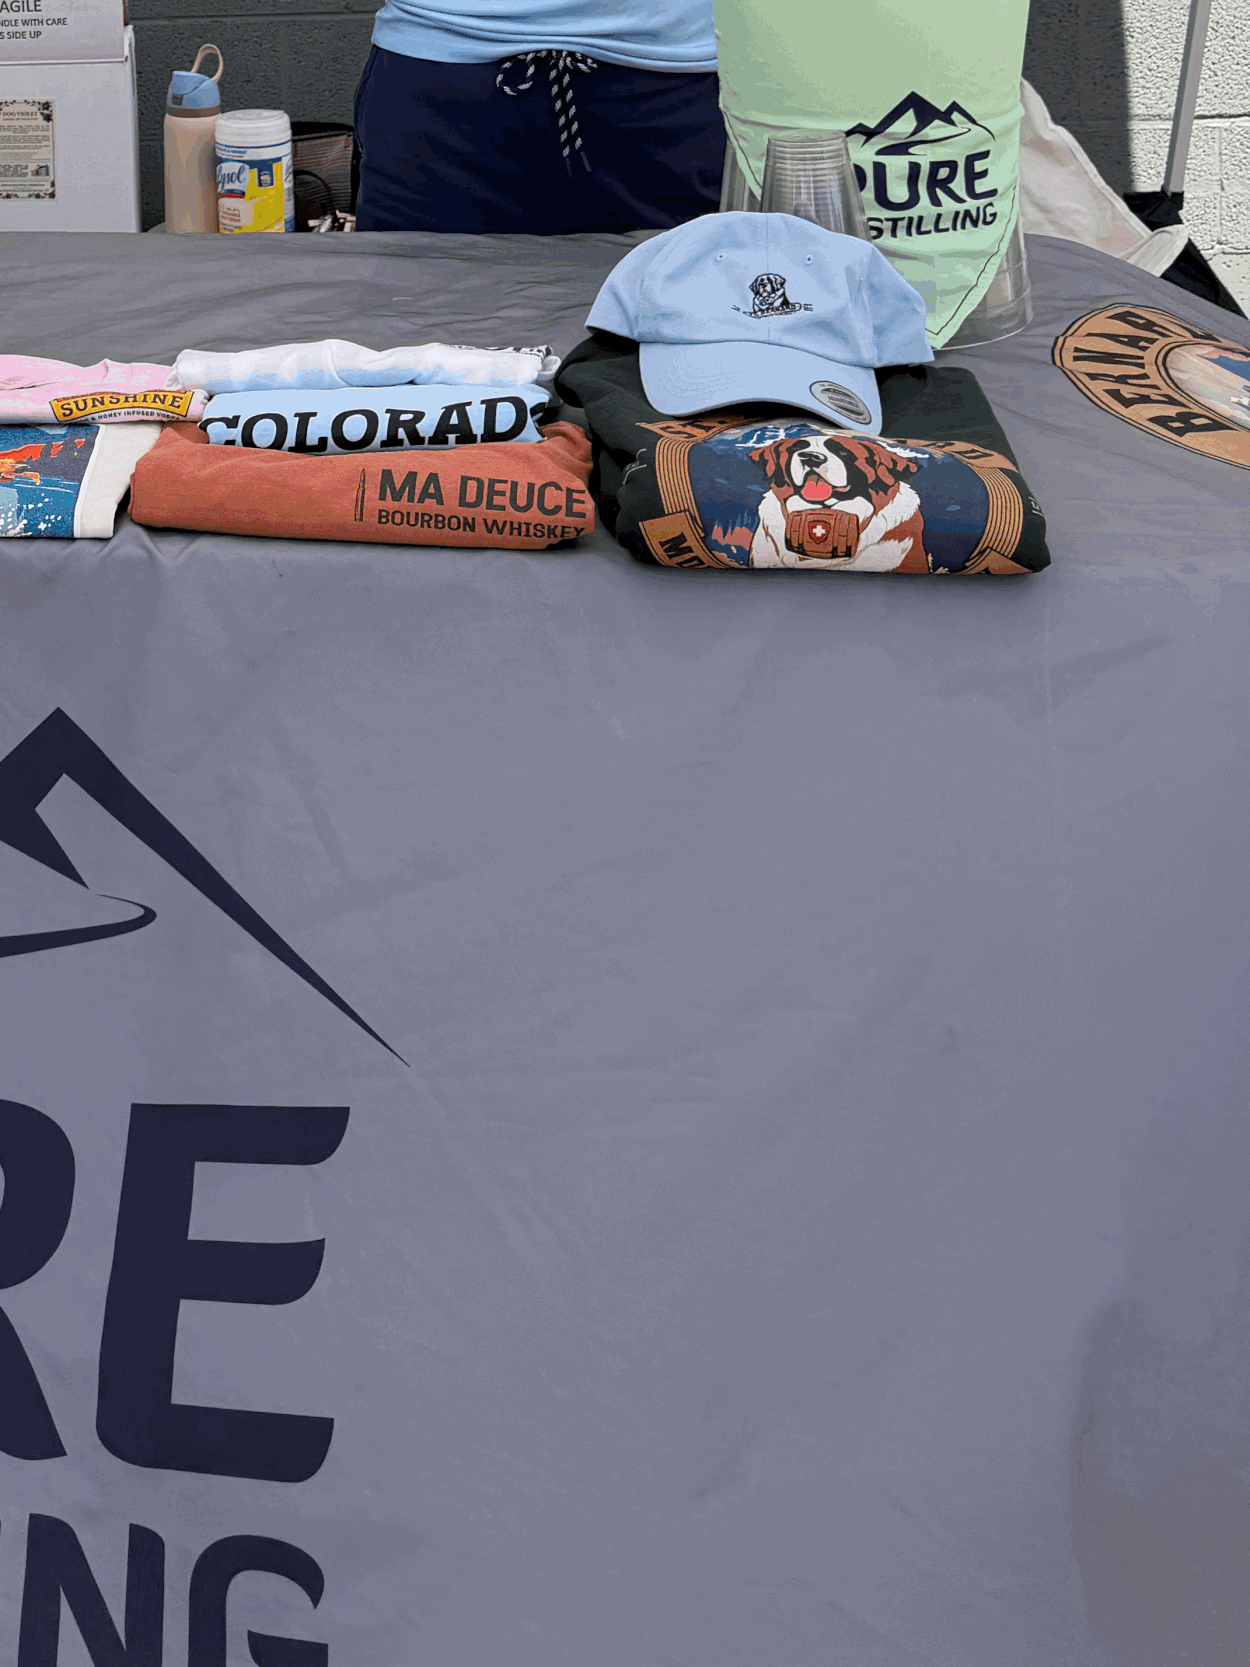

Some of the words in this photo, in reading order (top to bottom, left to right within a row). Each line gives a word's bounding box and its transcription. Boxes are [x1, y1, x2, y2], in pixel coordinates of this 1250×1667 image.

[21, 18, 44, 27] WITH
[45, 17, 68, 26] CARE
[6, 30, 27, 40] SIDE
[29, 30, 42, 39] UP
[866, 201, 998, 241] STILLING
[60, 393, 184, 418] SUNSHINE
[97, 412, 122, 420] HONEY
[378, 469, 444, 506] MA
[458, 475, 587, 519] DEUCE
[377, 508, 476, 533] BOURBON
[482, 518, 586, 540] WHISKEY
